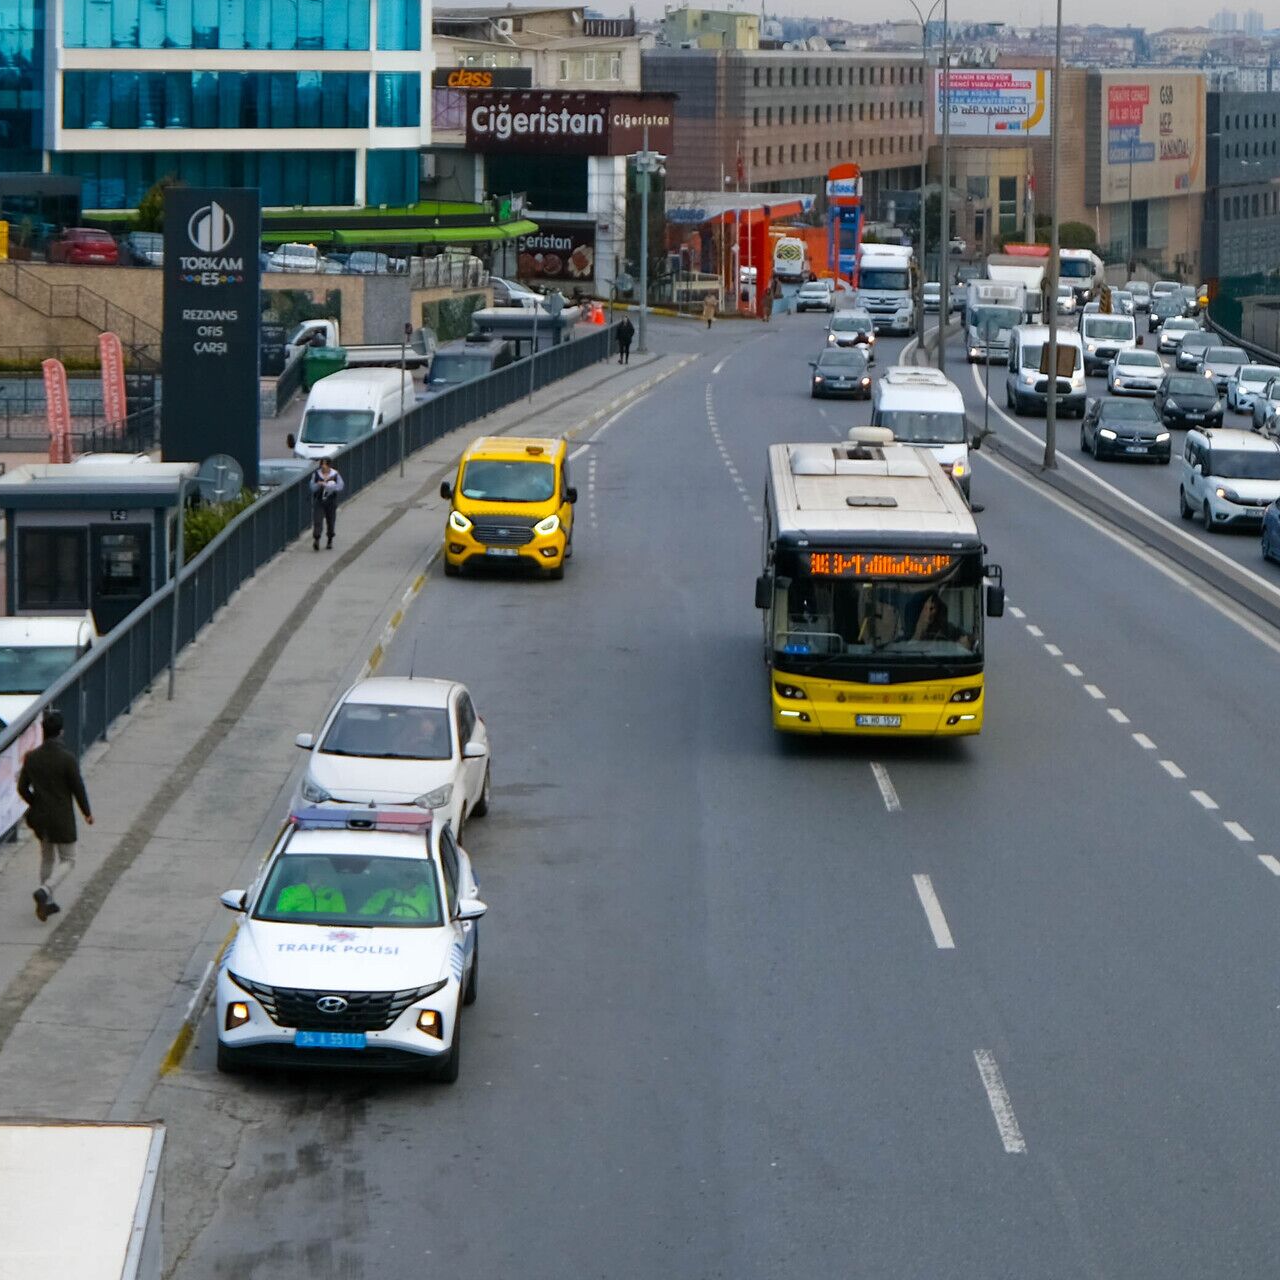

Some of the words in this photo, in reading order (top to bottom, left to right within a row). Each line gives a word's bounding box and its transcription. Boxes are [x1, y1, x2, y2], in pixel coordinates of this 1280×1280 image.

[447, 68, 492, 86] class
[1160, 84, 1174, 105] GSB
[471, 103, 603, 139] Ciğeristan
[613, 114, 670, 129] Ciğeristan
[179, 256, 243, 271] TORKAM
